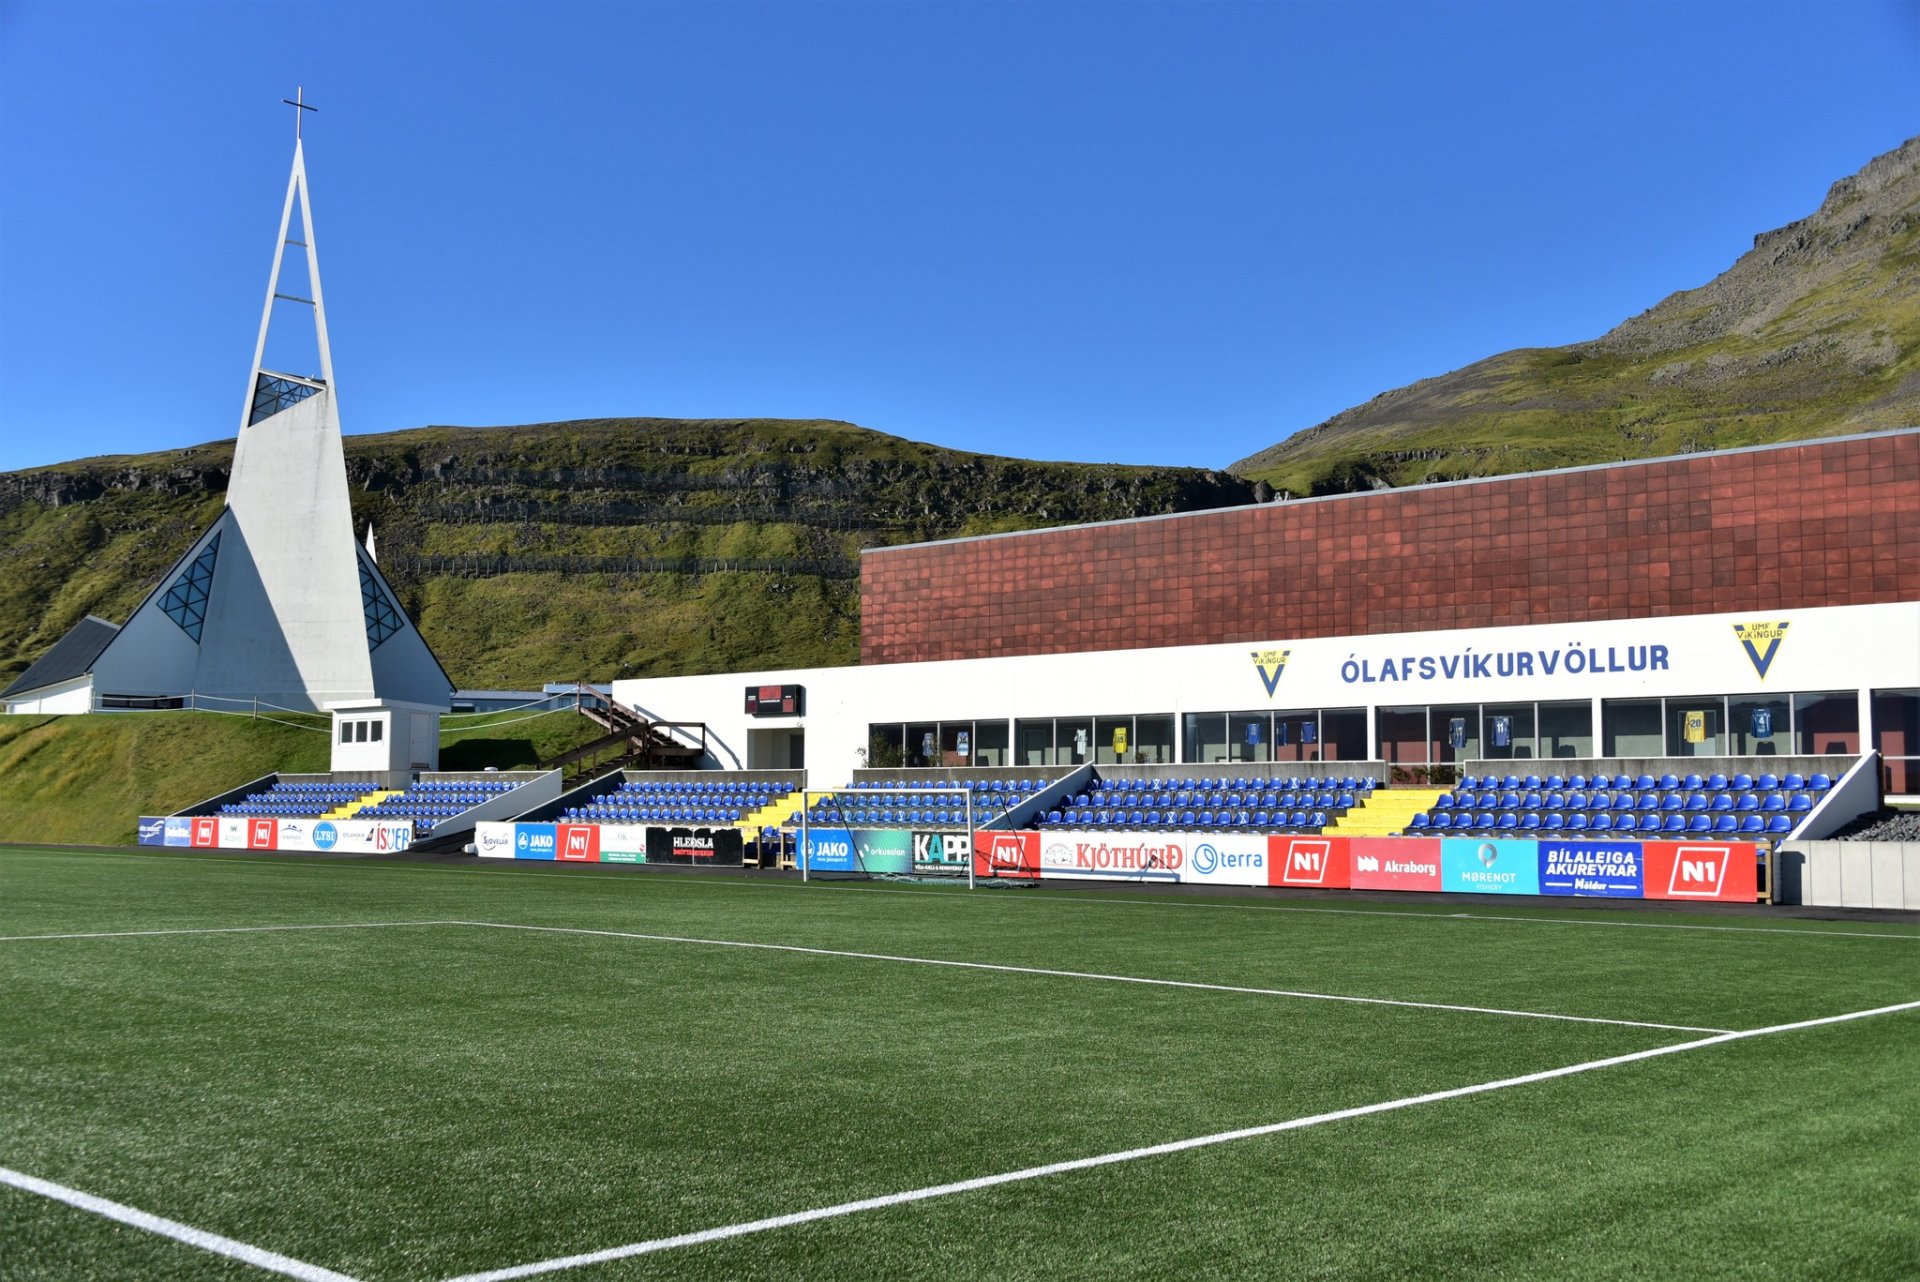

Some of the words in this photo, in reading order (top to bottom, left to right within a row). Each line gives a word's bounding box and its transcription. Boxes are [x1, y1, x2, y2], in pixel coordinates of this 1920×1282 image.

[1752, 622, 1770, 631] UMF
[1341, 643, 1669, 683] ÓLAFSVÍKURVÖLLUR
[1496, 722, 1504, 733] 11
[1690, 719, 1701, 728] 20
[257, 828, 268, 839] N1
[529, 834, 553, 847] JAKO
[570, 836, 585, 850] N1
[817, 842, 848, 857] JAKO
[870, 847, 906, 857] orkusalan
[997, 846, 1018, 862] N1
[1076, 842, 1183, 871] KJÖTHÚSIÐ
[1221, 851, 1263, 867] terra
[1547, 847, 1635, 864] BÍLALEIGA
[1294, 852, 1320, 871] N1
[1384, 860, 1437, 876] Akraborg
[1545, 863, 1638, 877] AKUREYRAR
[1681, 860, 1717, 883] N1
[1461, 872, 1517, 884] MØRENOT
[1476, 883, 1503, 891] FISHERY
